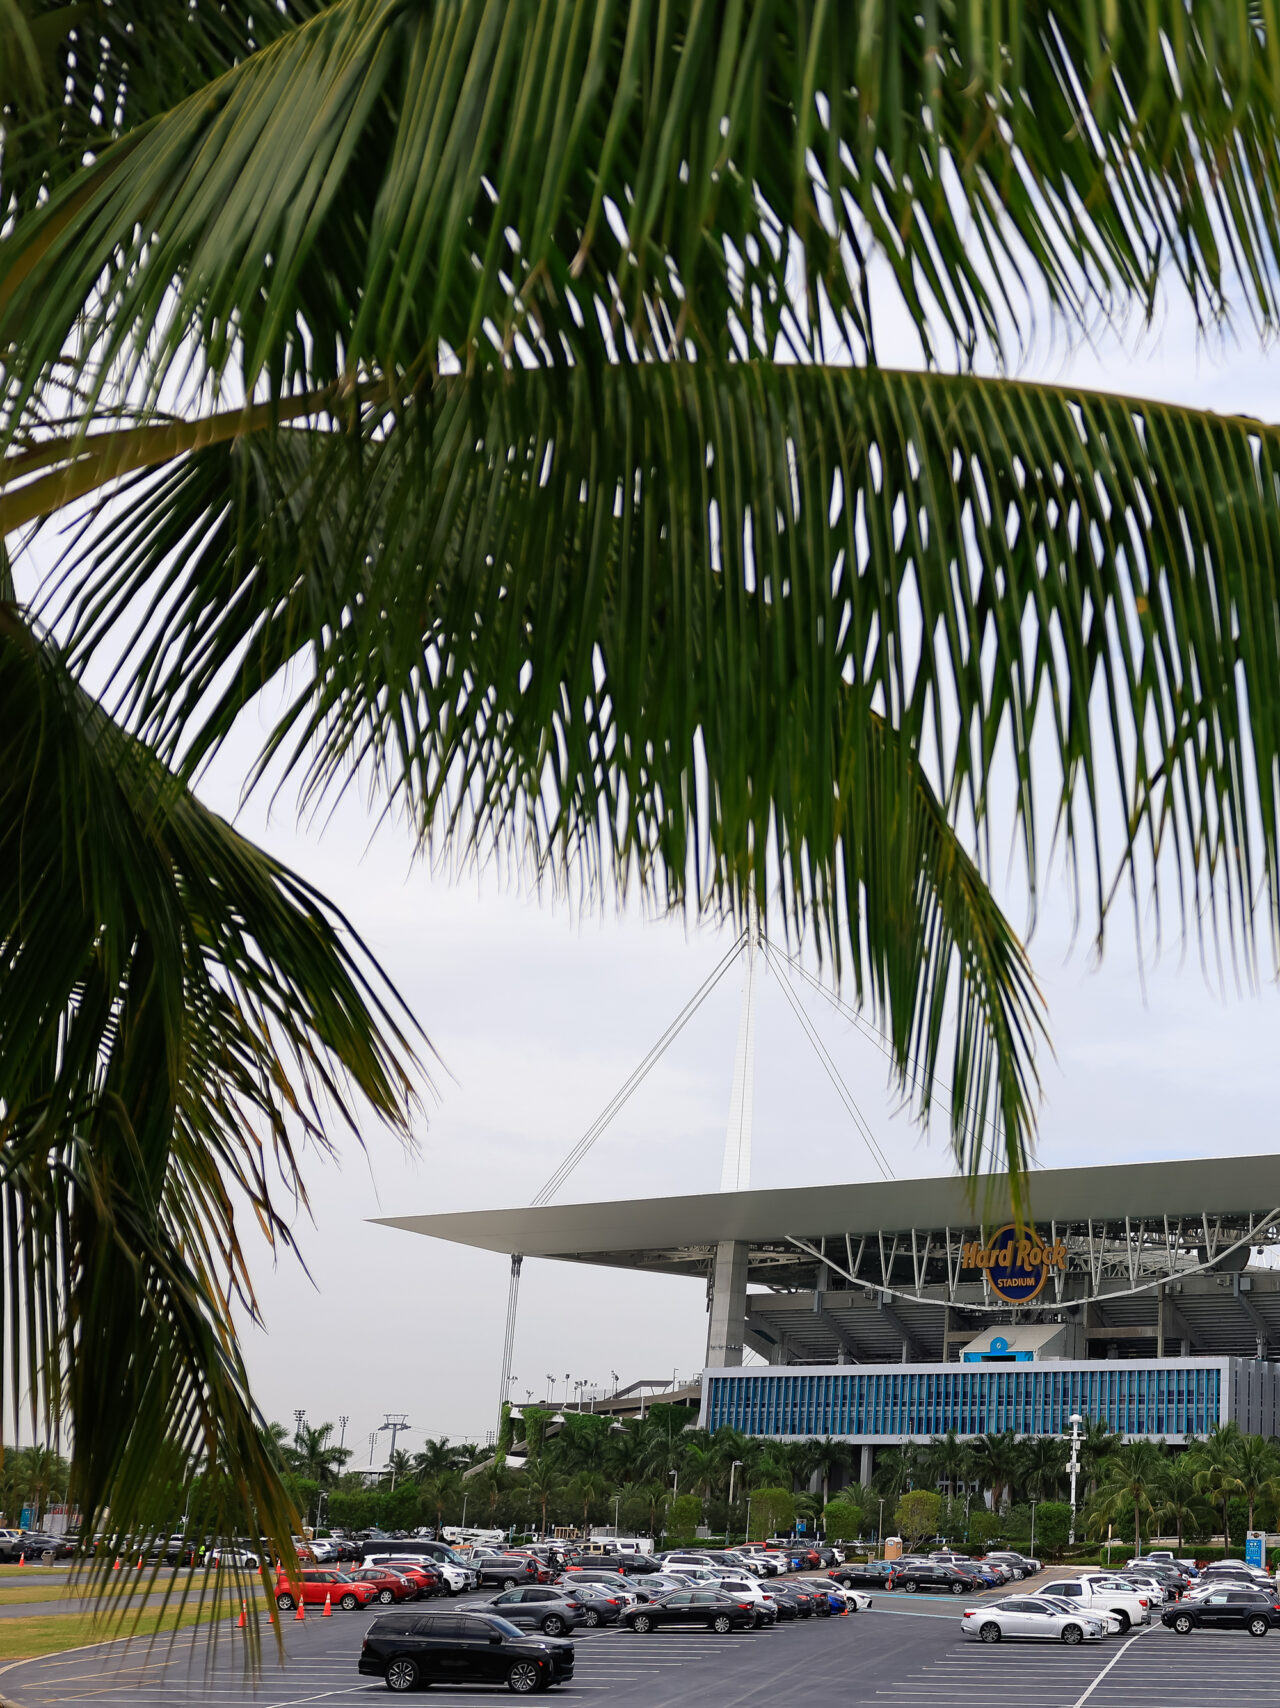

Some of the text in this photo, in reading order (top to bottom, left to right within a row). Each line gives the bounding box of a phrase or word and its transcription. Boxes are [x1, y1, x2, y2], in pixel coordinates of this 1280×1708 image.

[962, 1237, 1067, 1271] Hard Rock
[998, 1278, 1035, 1288] STADIUM
